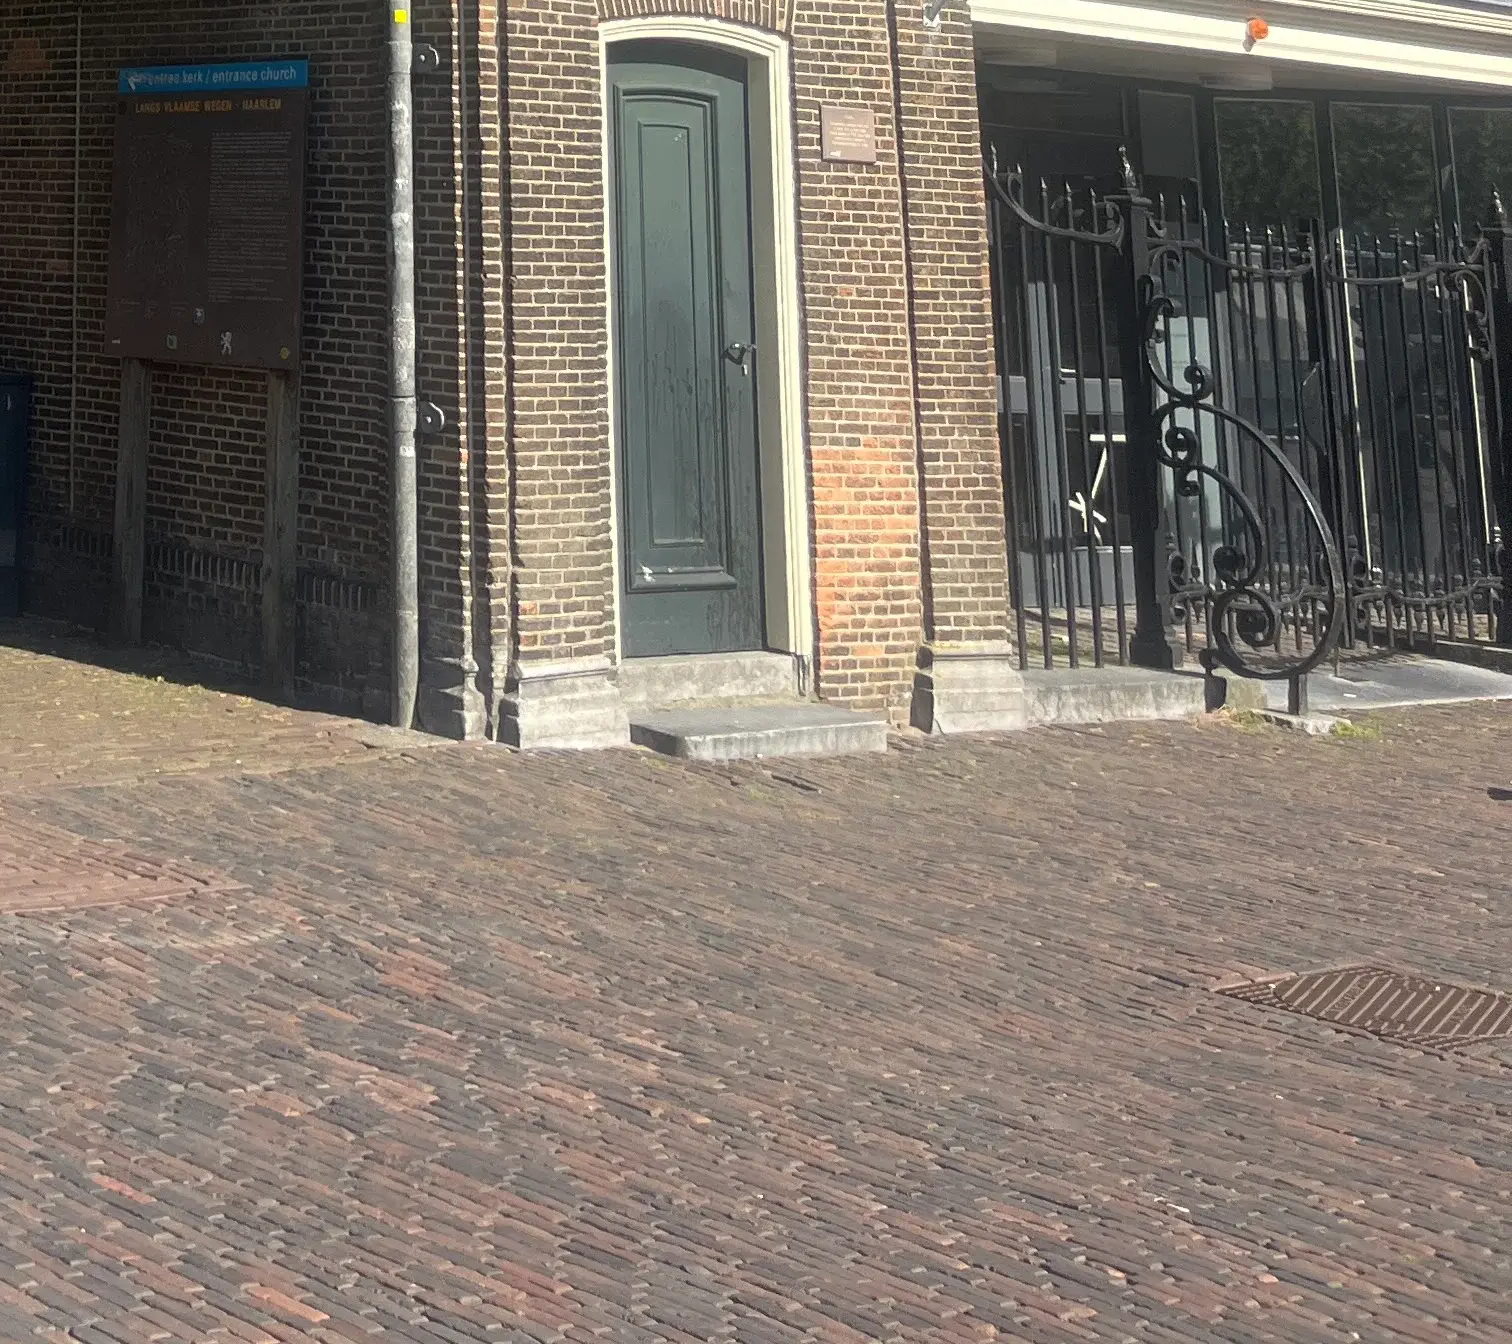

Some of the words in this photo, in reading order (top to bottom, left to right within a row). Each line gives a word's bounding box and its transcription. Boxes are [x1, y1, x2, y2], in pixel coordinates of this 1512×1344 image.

[182, 70, 203, 84] kerk
[212, 69, 258, 83] entrance
[260, 65, 297, 81] church
[204, 99, 232, 112] WEGEN
[242, 98, 282, 110] HAARLEM
